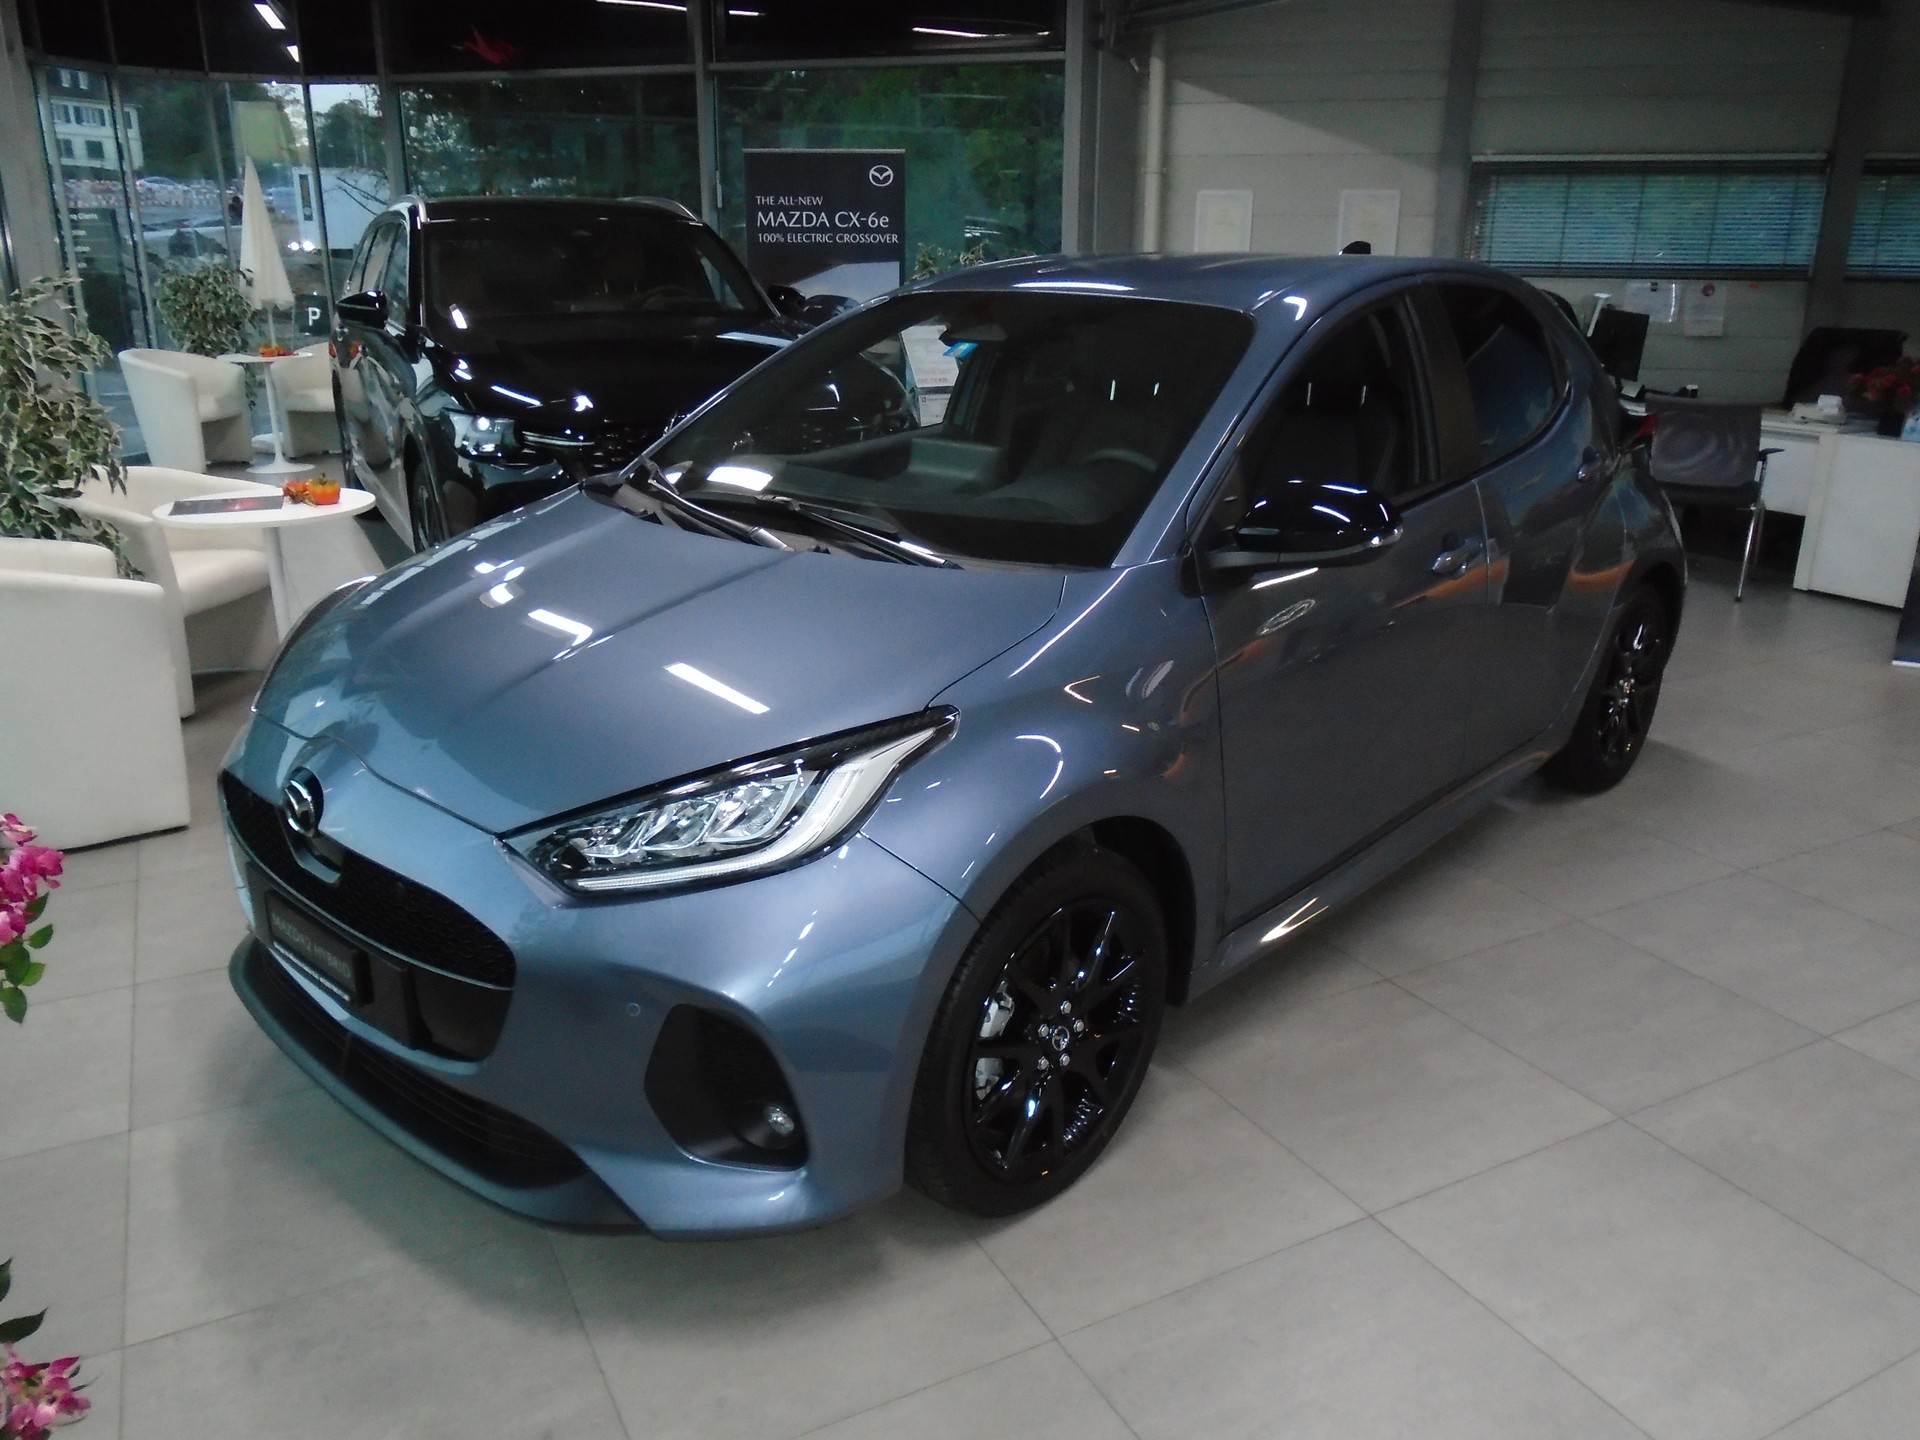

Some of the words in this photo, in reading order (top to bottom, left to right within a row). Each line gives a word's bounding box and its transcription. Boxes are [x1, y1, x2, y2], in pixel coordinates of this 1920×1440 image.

[755, 196, 775, 206] THE
[777, 196, 823, 206] ALL-NEW
[757, 211, 830, 228] MAZDA
[834, 211, 890, 228] CX-6e
[758, 233, 785, 243] 100%
[787, 233, 833, 243] ELECTRIC
[836, 233, 899, 244] CROSSOVER
[308, 307, 322, 326] P
